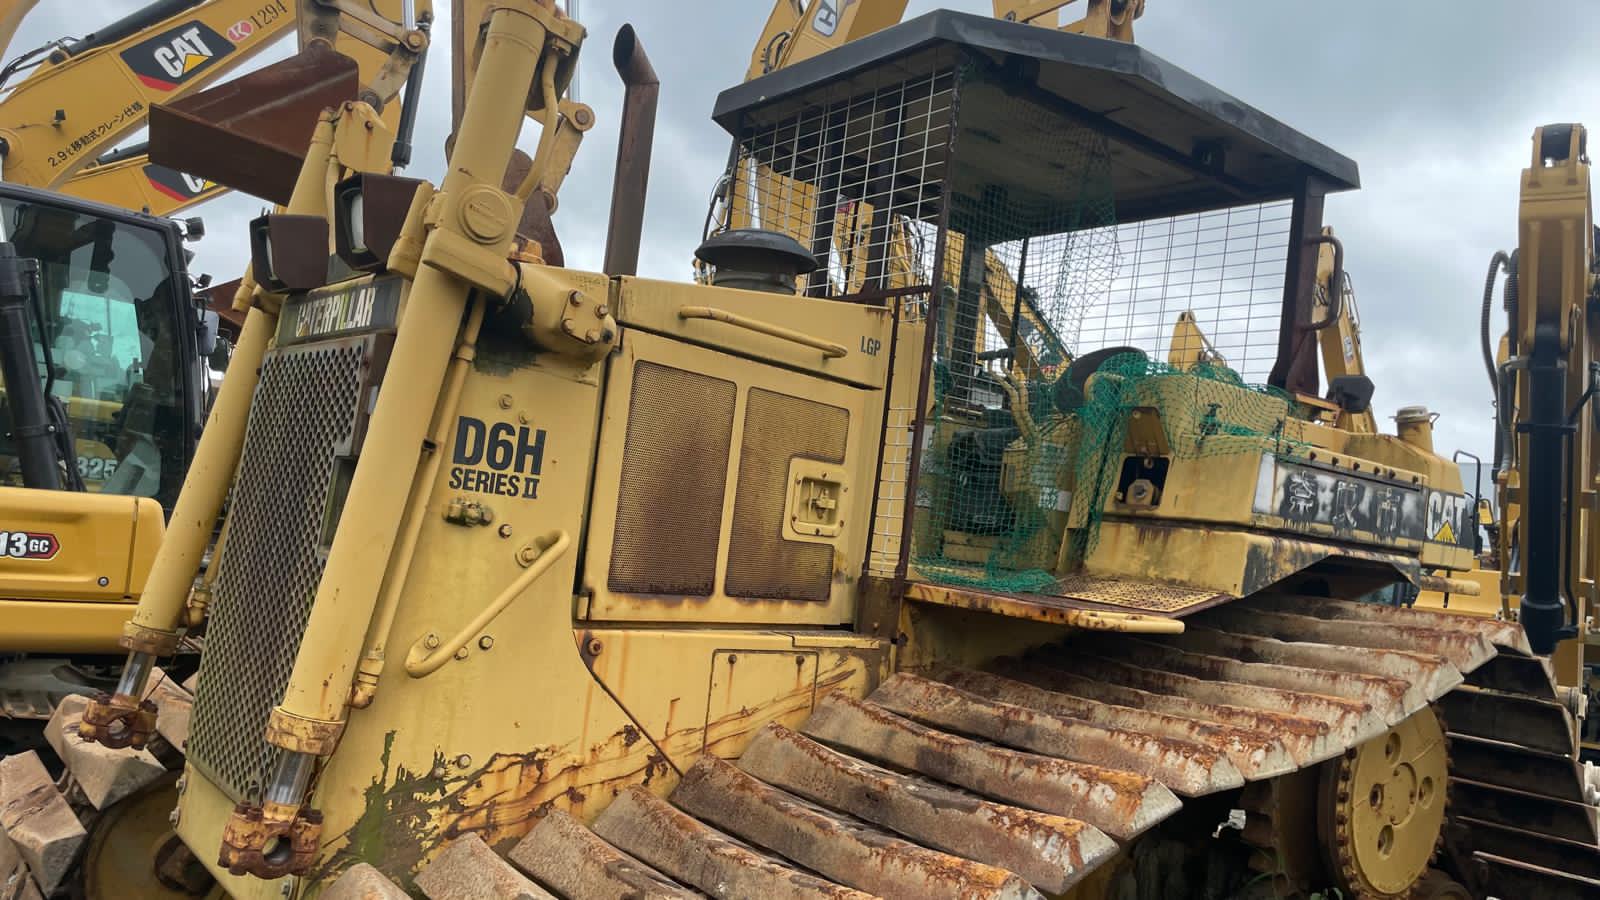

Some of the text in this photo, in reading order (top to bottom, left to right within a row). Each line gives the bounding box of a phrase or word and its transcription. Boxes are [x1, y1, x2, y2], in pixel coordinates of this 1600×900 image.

[154, 27, 213, 78] CAT
[296, 287, 376, 338] CATERPILLAR
[860, 335, 881, 357] LGP
[453, 416, 547, 475] D6H
[449, 467, 540, 499] SERIES II
[1426, 491, 1466, 545] CAT
[29, 539, 49, 553] GC
